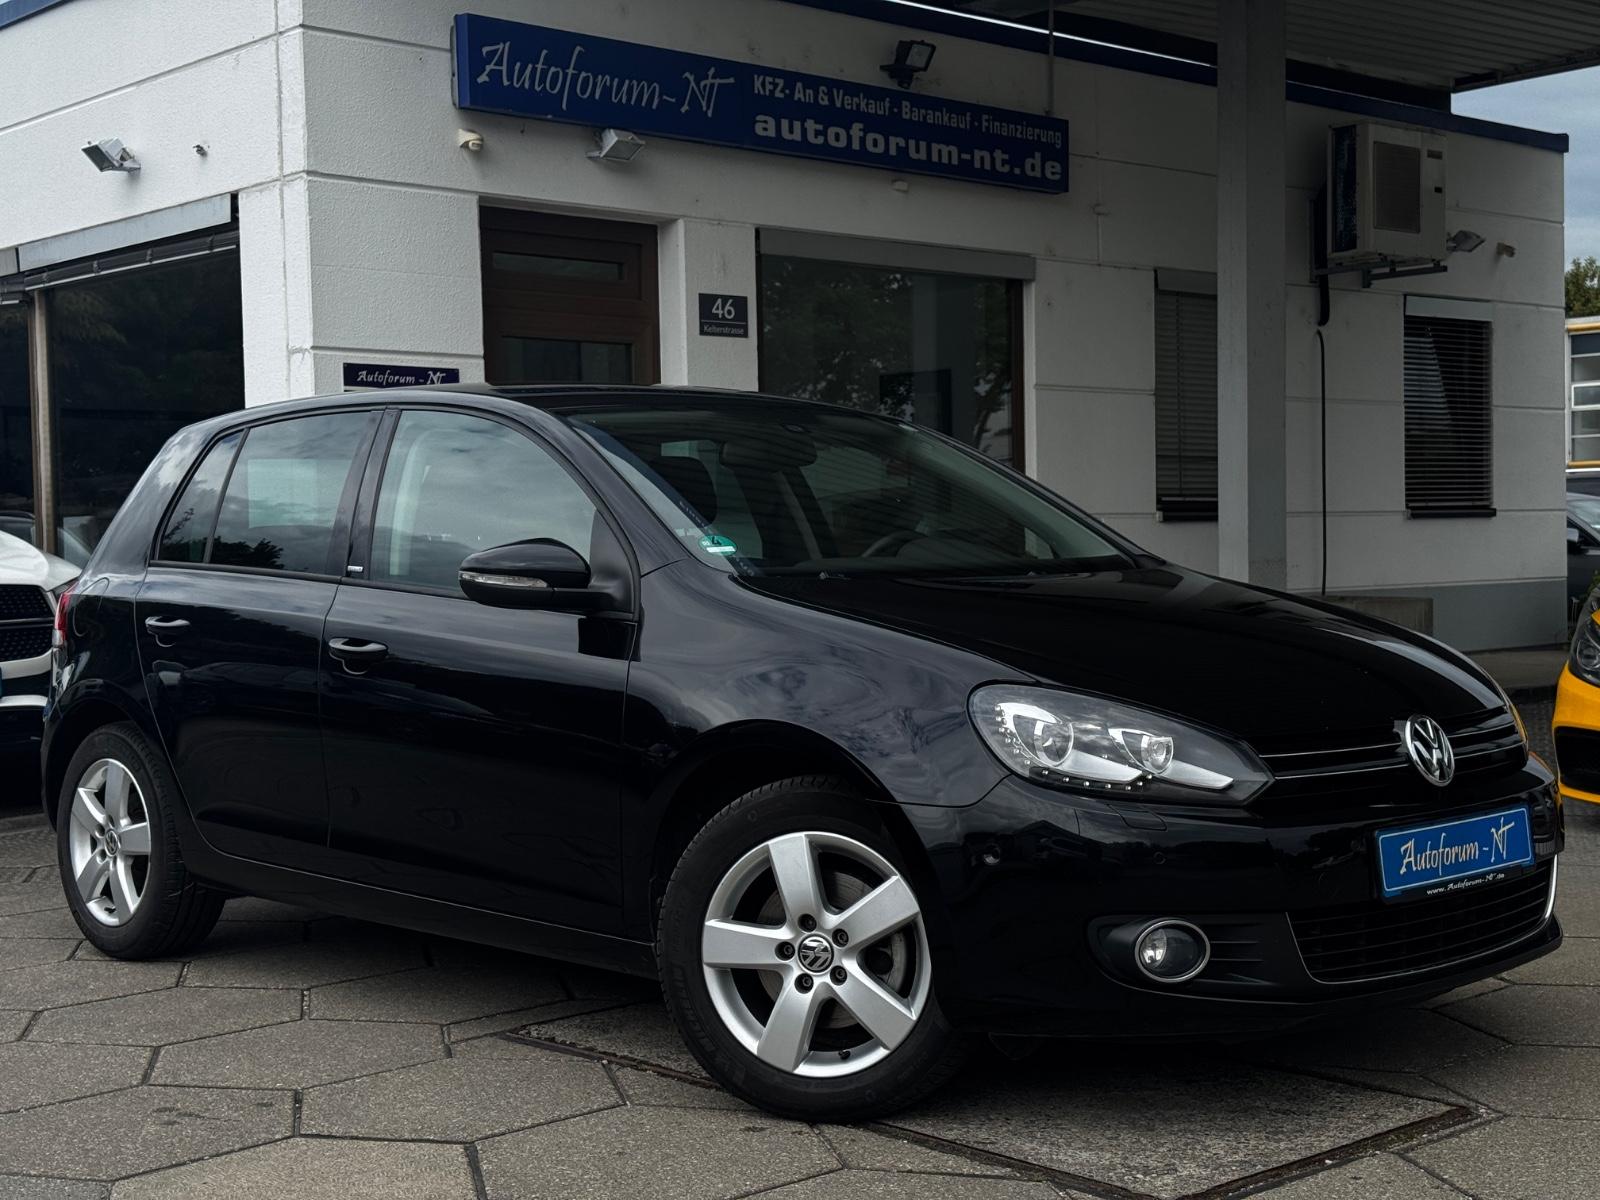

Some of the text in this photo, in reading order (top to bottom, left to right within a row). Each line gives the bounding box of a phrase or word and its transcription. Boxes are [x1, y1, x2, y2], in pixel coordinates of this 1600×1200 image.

[754, 114, 1062, 181] autoforum-nt.de
[794, 82, 814, 104] An
[818, 86, 830, 106] &
[833, 88, 890, 116] Verkauf
[901, 100, 972, 129] Barankauf
[981, 114, 1062, 149] Finanzierung
[711, 298, 735, 319] 46
